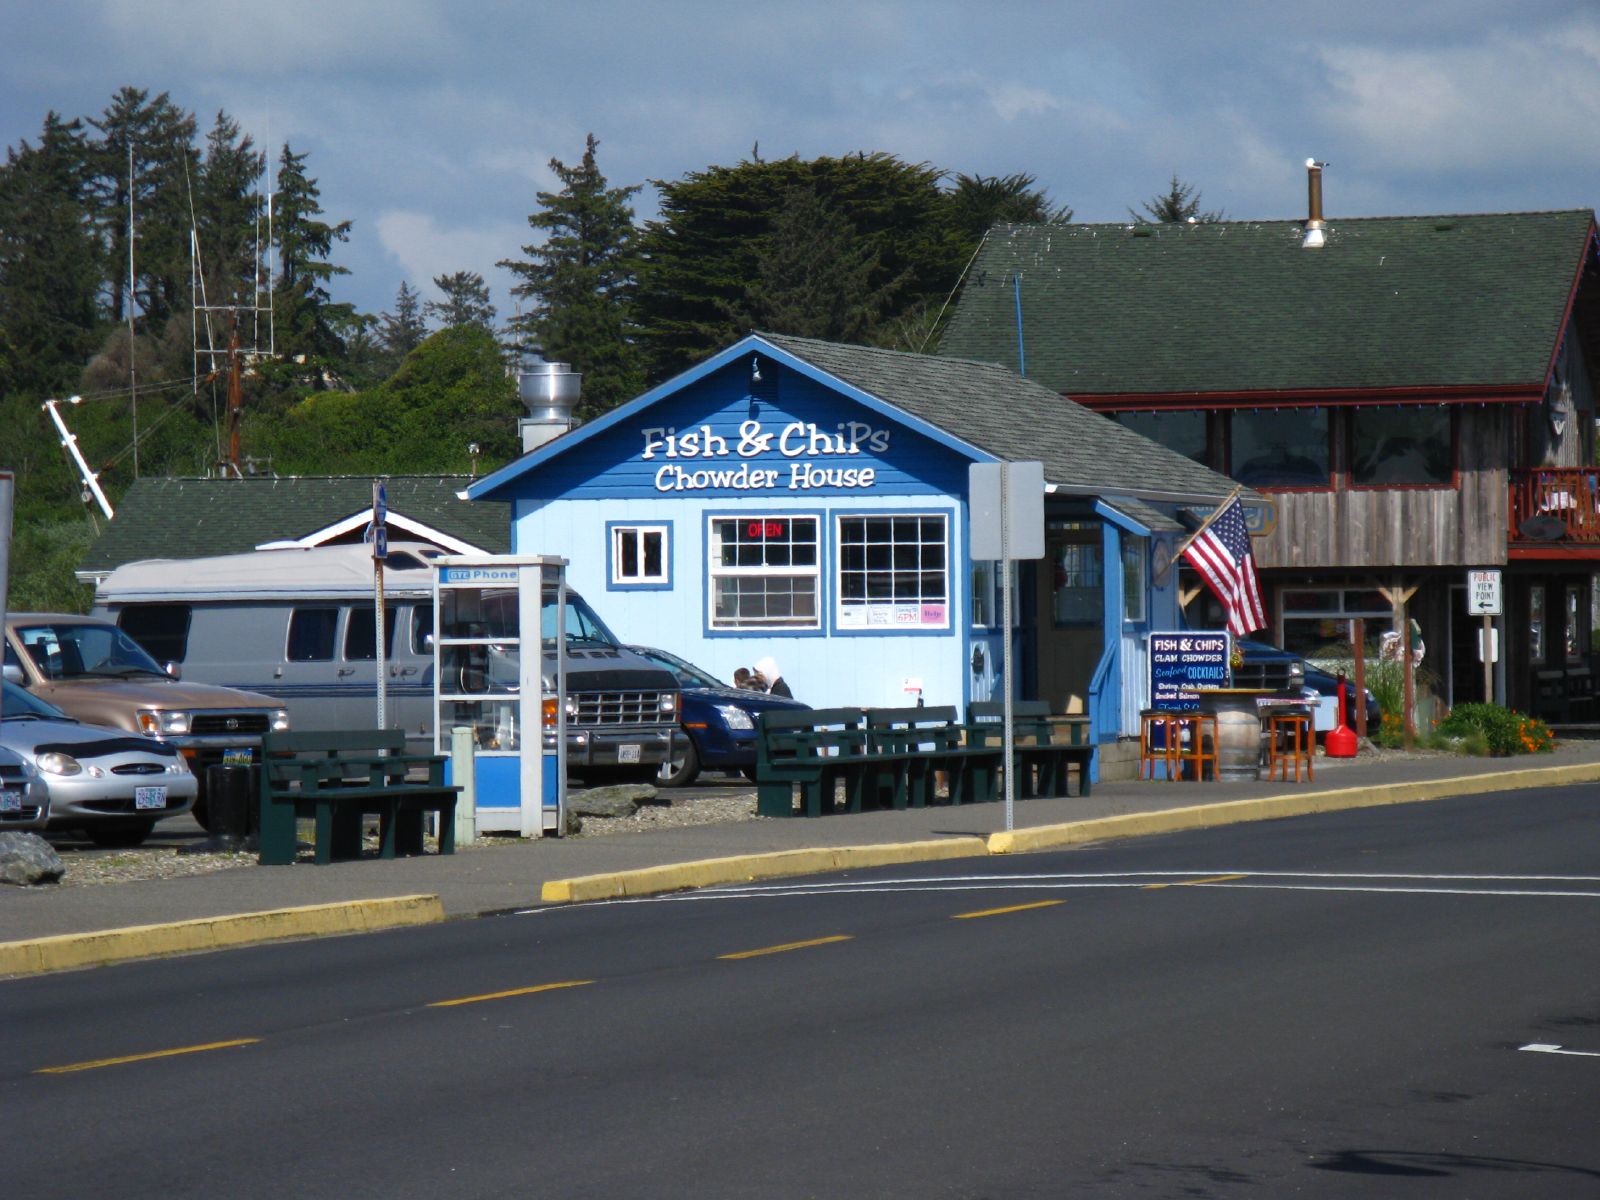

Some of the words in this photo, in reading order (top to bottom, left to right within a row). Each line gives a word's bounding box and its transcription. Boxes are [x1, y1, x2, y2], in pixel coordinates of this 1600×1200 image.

[641, 425, 729, 459] Fish
[736, 420, 774, 457] &
[655, 463, 779, 492] Chowder
[788, 462, 876, 490] House
[748, 523, 784, 537] OPEN
[473, 570, 518, 579] Phone
[1473, 572, 1496, 581] PUBLIC
[1477, 582, 1494, 591] VIEW
[1475, 591, 1495, 600] POINT
[1154, 639, 1178, 651] FISH
[1179, 638, 1194, 651] &
[1194, 639, 1225, 651] CHIPS
[1154, 654, 1178, 663] CLAM
[1181, 654, 1223, 663] CHOWDER
[1155, 665, 1187, 679] Seafood
[1187, 666, 1225, 680] COCKTAILS
[1178, 692, 1200, 700] Salmon
